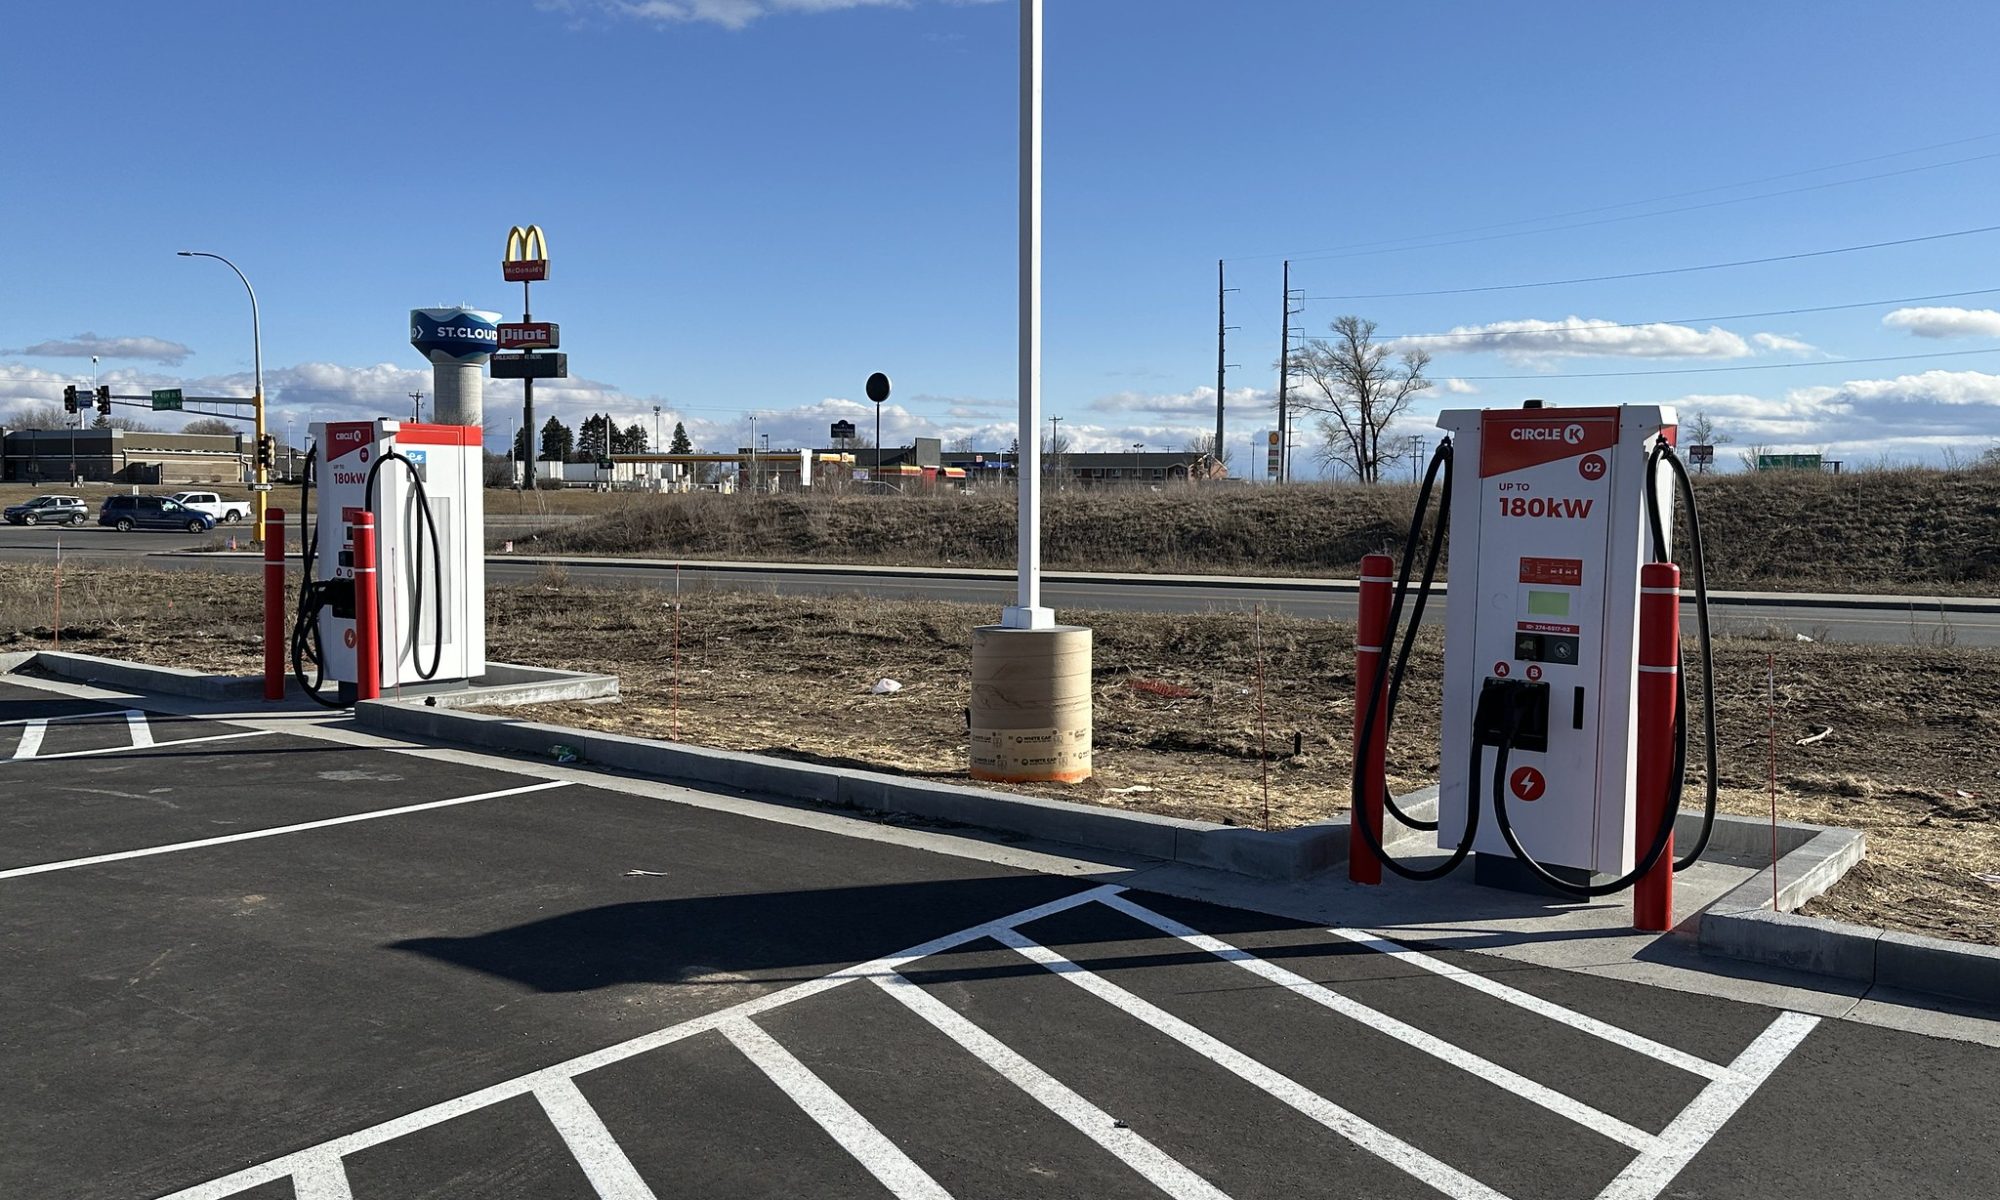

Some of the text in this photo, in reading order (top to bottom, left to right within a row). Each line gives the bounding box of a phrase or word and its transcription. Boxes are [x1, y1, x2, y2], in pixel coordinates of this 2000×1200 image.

[505, 266, 543, 274] McDonald's
[501, 328, 547, 344] Pilot
[335, 432, 353, 440] CIRCLE
[1510, 426, 1584, 442] CIRCLE K
[1584, 462, 1601, 472] 02
[334, 472, 366, 484] 180kW
[1499, 483, 1530, 491] UP TO
[1499, 497, 1593, 519] 180kW
[1497, 665, 1506, 674] A
[1530, 668, 1539, 677] B
